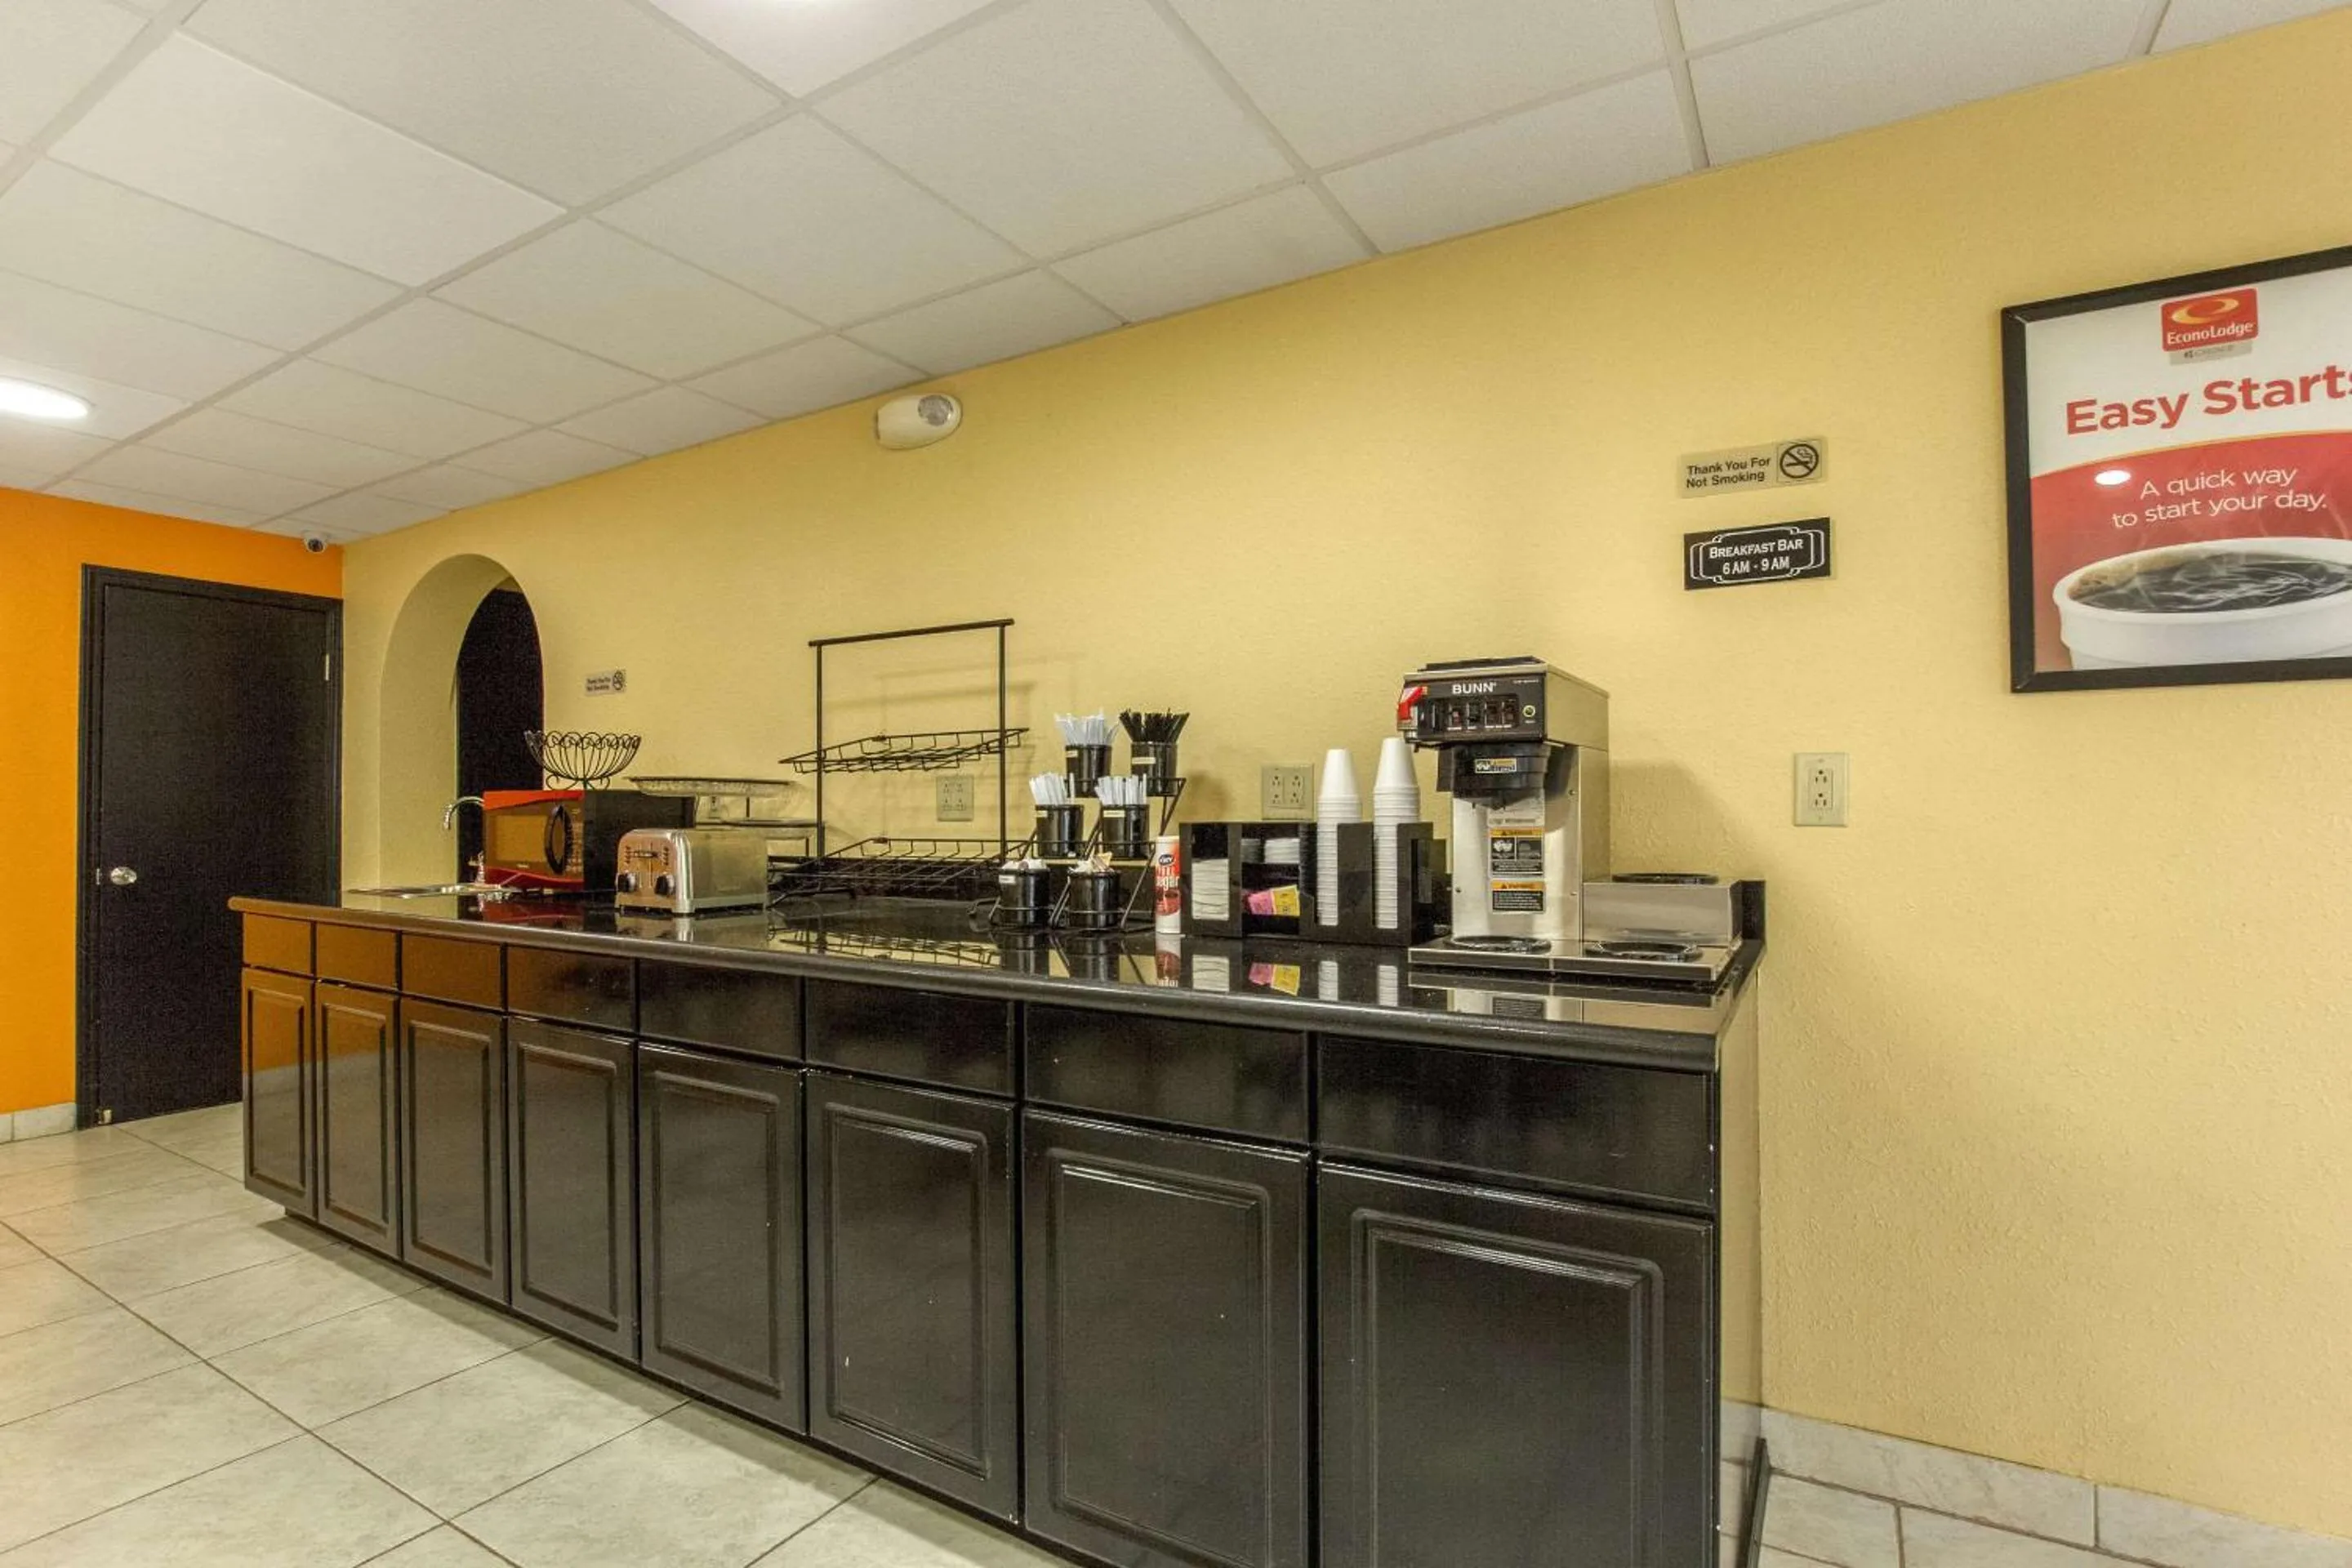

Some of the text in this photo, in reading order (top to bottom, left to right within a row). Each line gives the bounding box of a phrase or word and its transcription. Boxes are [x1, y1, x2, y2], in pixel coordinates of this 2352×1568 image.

[2066, 365, 2352, 435] Easy Start
[1686, 457, 1771, 475] Thank You For
[1686, 471, 1766, 488] Not Smoking
[2140, 468, 2298, 500] A quick way
[2112, 489, 2328, 528] to start your day.
[1708, 538, 1804, 559] BREAKFAST BAR
[1722, 562, 1731, 575] 6
[1731, 560, 1750, 575] AM
[1761, 558, 1770, 572] 9
[1771, 556, 1790, 570] AM
[1452, 683, 1494, 694] BUNN
